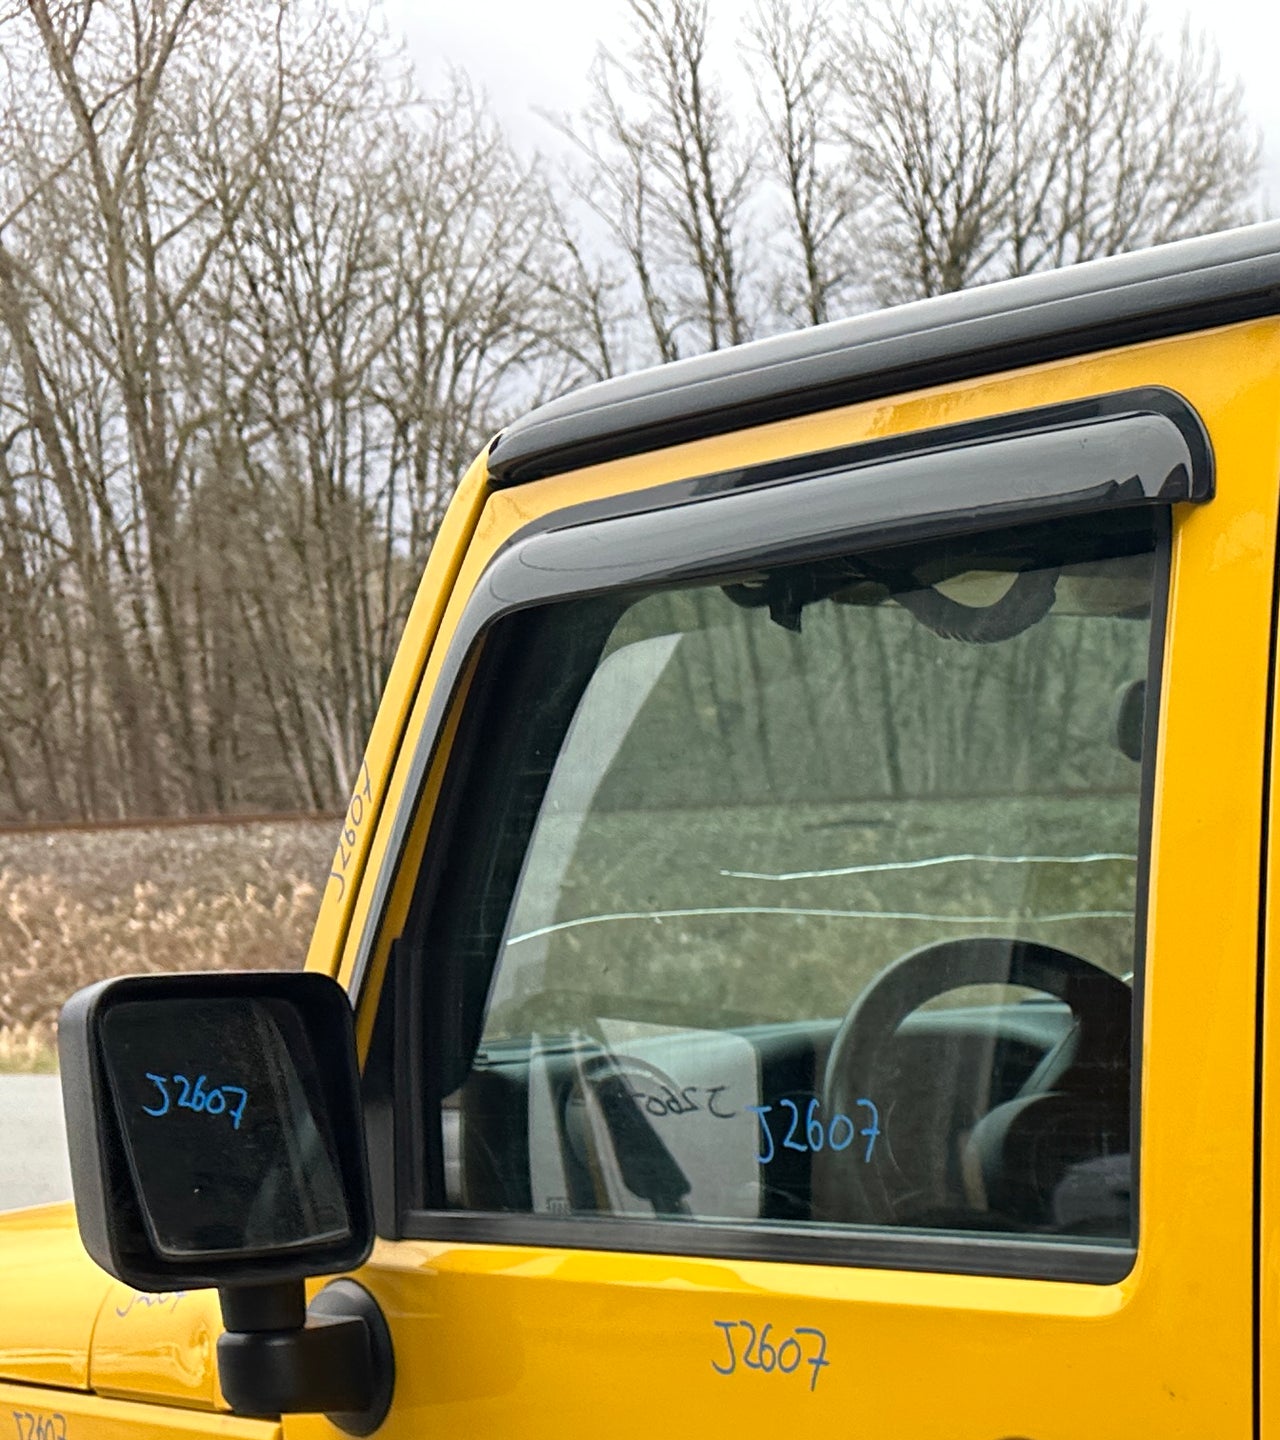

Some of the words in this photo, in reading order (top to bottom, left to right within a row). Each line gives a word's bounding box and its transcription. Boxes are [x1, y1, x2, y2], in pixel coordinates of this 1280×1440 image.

[142, 1071, 249, 1129] J2607
[745, 1097, 881, 1164] J2607
[711, 1319, 830, 1393] J2607
